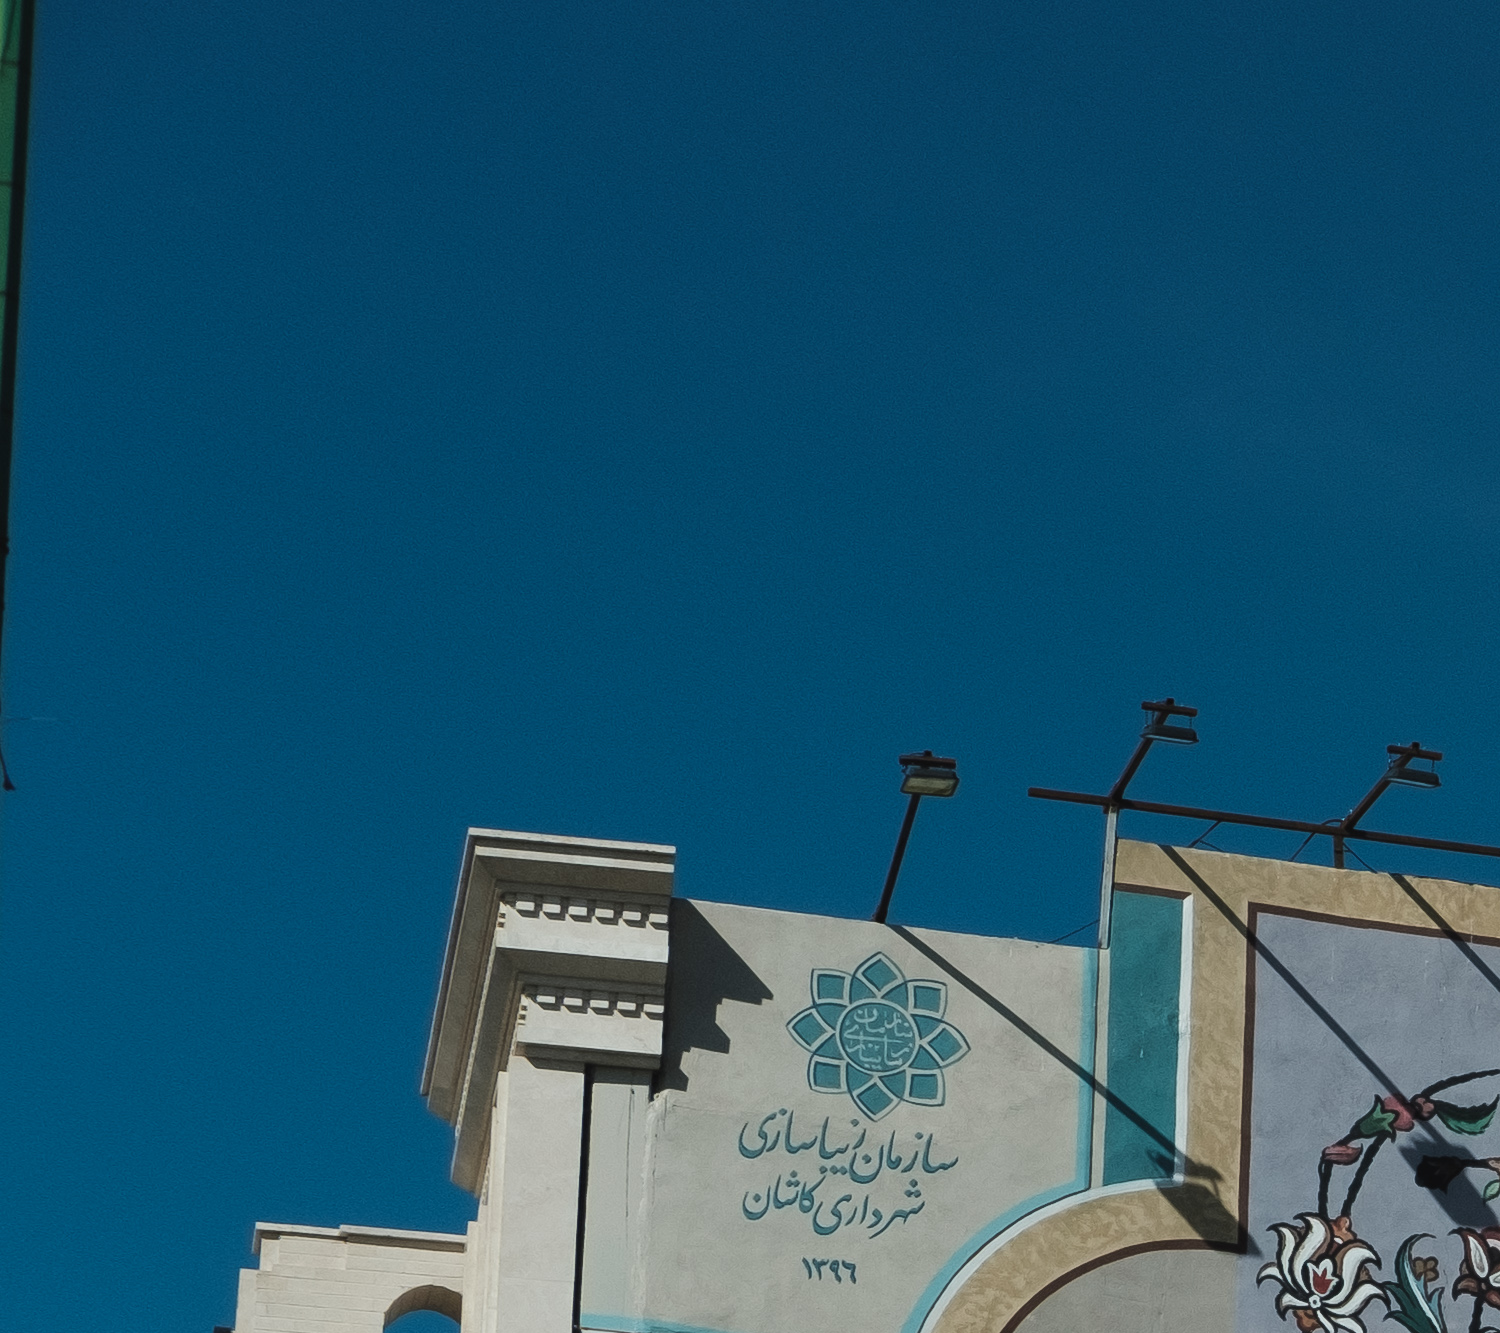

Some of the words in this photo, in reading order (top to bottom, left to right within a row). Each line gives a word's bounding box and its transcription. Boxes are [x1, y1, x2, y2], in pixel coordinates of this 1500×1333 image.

[737, 1107, 867, 1176] زیباسازی
[849, 1130, 959, 1185] سازمان
[741, 1167, 830, 1221] کاشان
[812, 1178, 926, 1240] شهرداری
